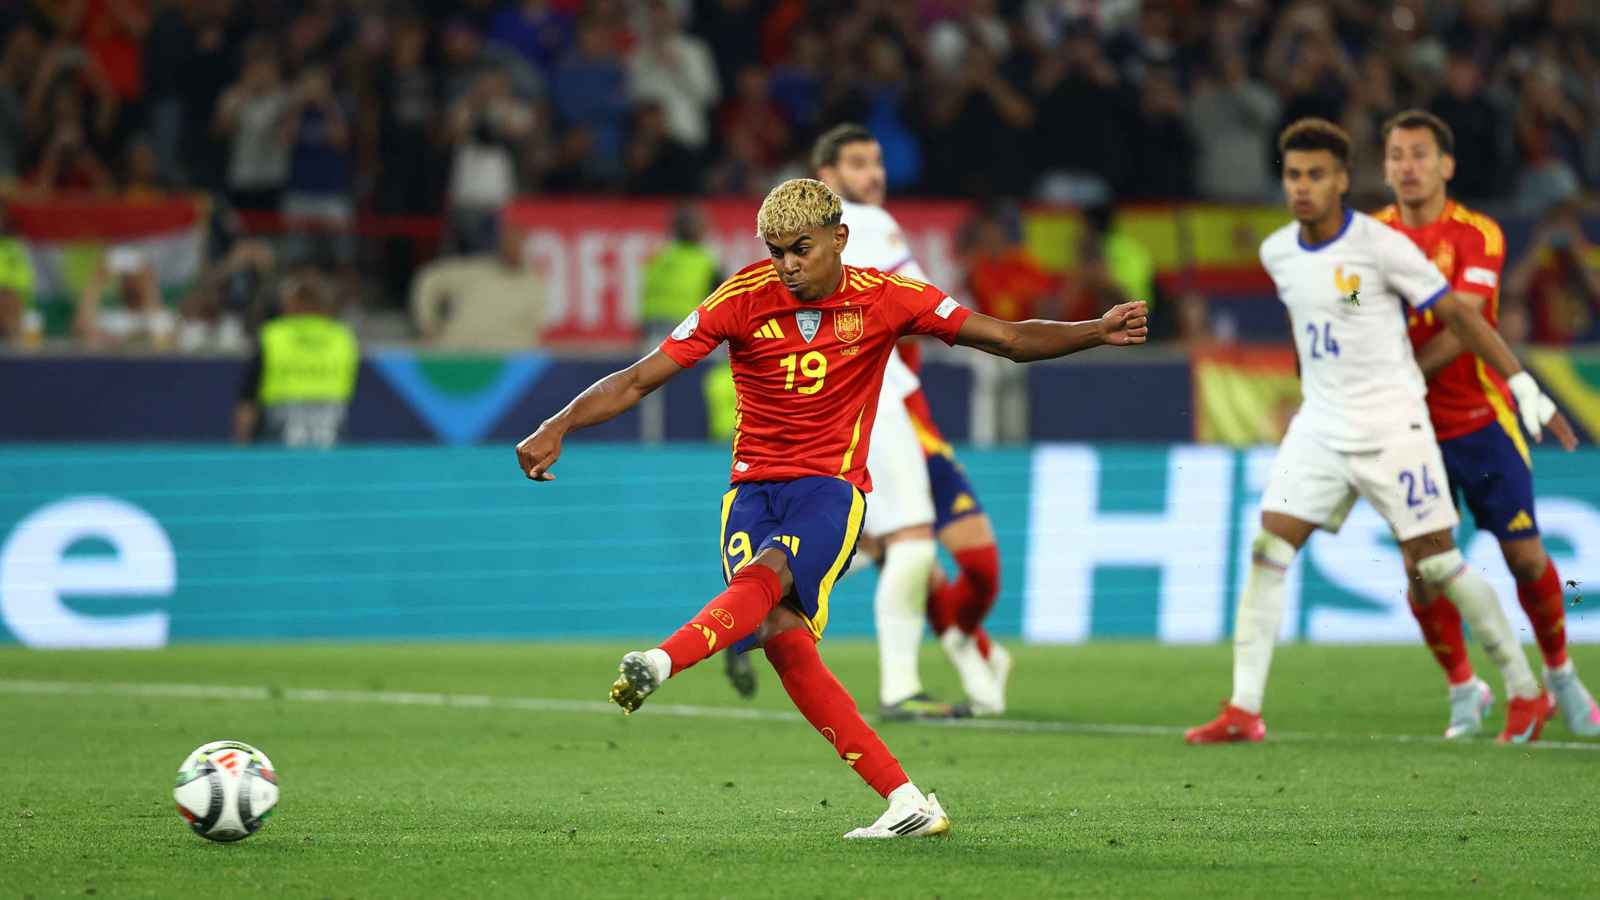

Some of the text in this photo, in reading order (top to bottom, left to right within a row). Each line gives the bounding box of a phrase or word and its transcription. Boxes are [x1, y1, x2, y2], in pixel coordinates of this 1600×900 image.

[1306, 321, 1341, 360] 24
[780, 351, 828, 394] 19
[1398, 463, 1440, 508] 24
[0, 494, 177, 649] e
